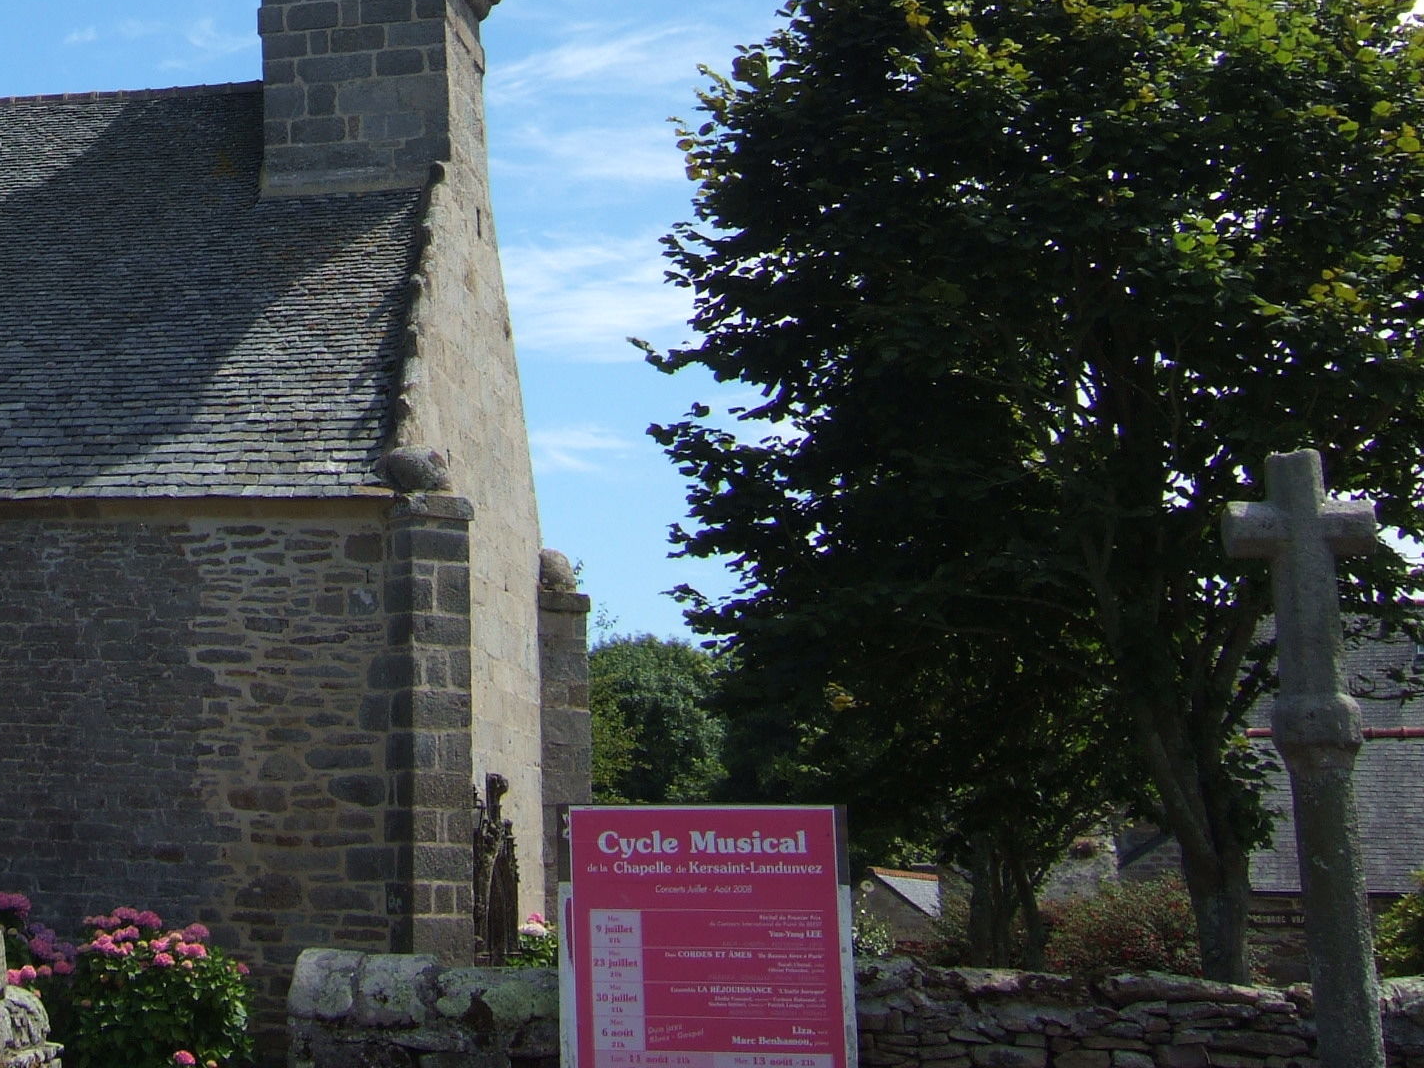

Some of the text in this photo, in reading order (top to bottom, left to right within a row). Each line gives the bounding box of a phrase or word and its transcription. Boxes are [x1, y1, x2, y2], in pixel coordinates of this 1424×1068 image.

[597, 830, 807, 858] Cycle Musical
[588, 860, 823, 876] de la Chapelle de Kersaint-Landunvez
[595, 924, 602, 933] 9
[602, 1027, 608, 1037] 6
